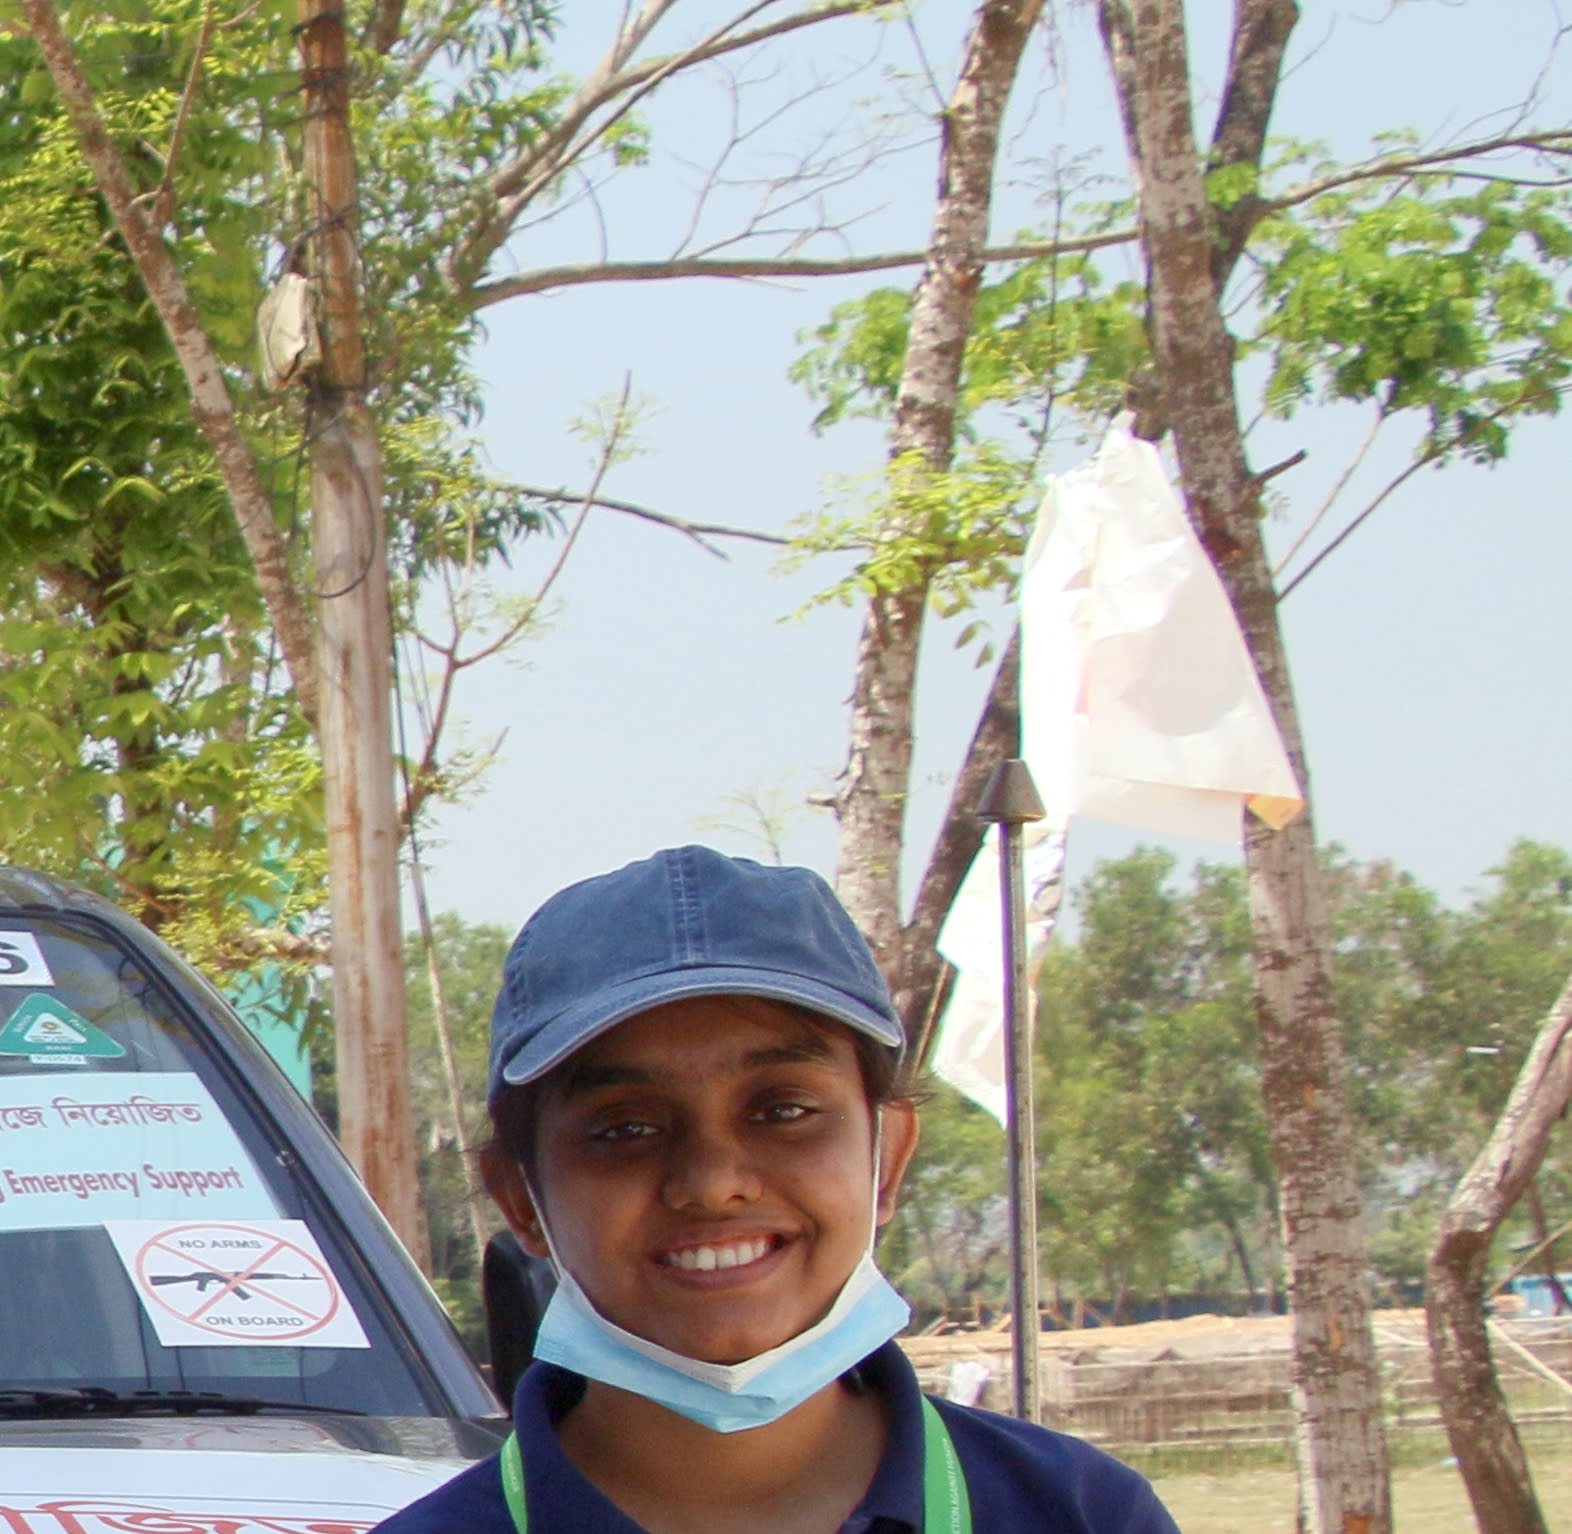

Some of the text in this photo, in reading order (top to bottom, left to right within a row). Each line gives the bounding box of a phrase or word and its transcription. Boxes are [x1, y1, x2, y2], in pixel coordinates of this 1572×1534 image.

[51, 1095, 203, 1128] নিয়োজিত
[3, 1168, 141, 1200] Emergency
[142, 1163, 245, 1198] Support
[178, 1239, 263, 1250] NO ARMS
[206, 1316, 305, 1327] ON BOARD
